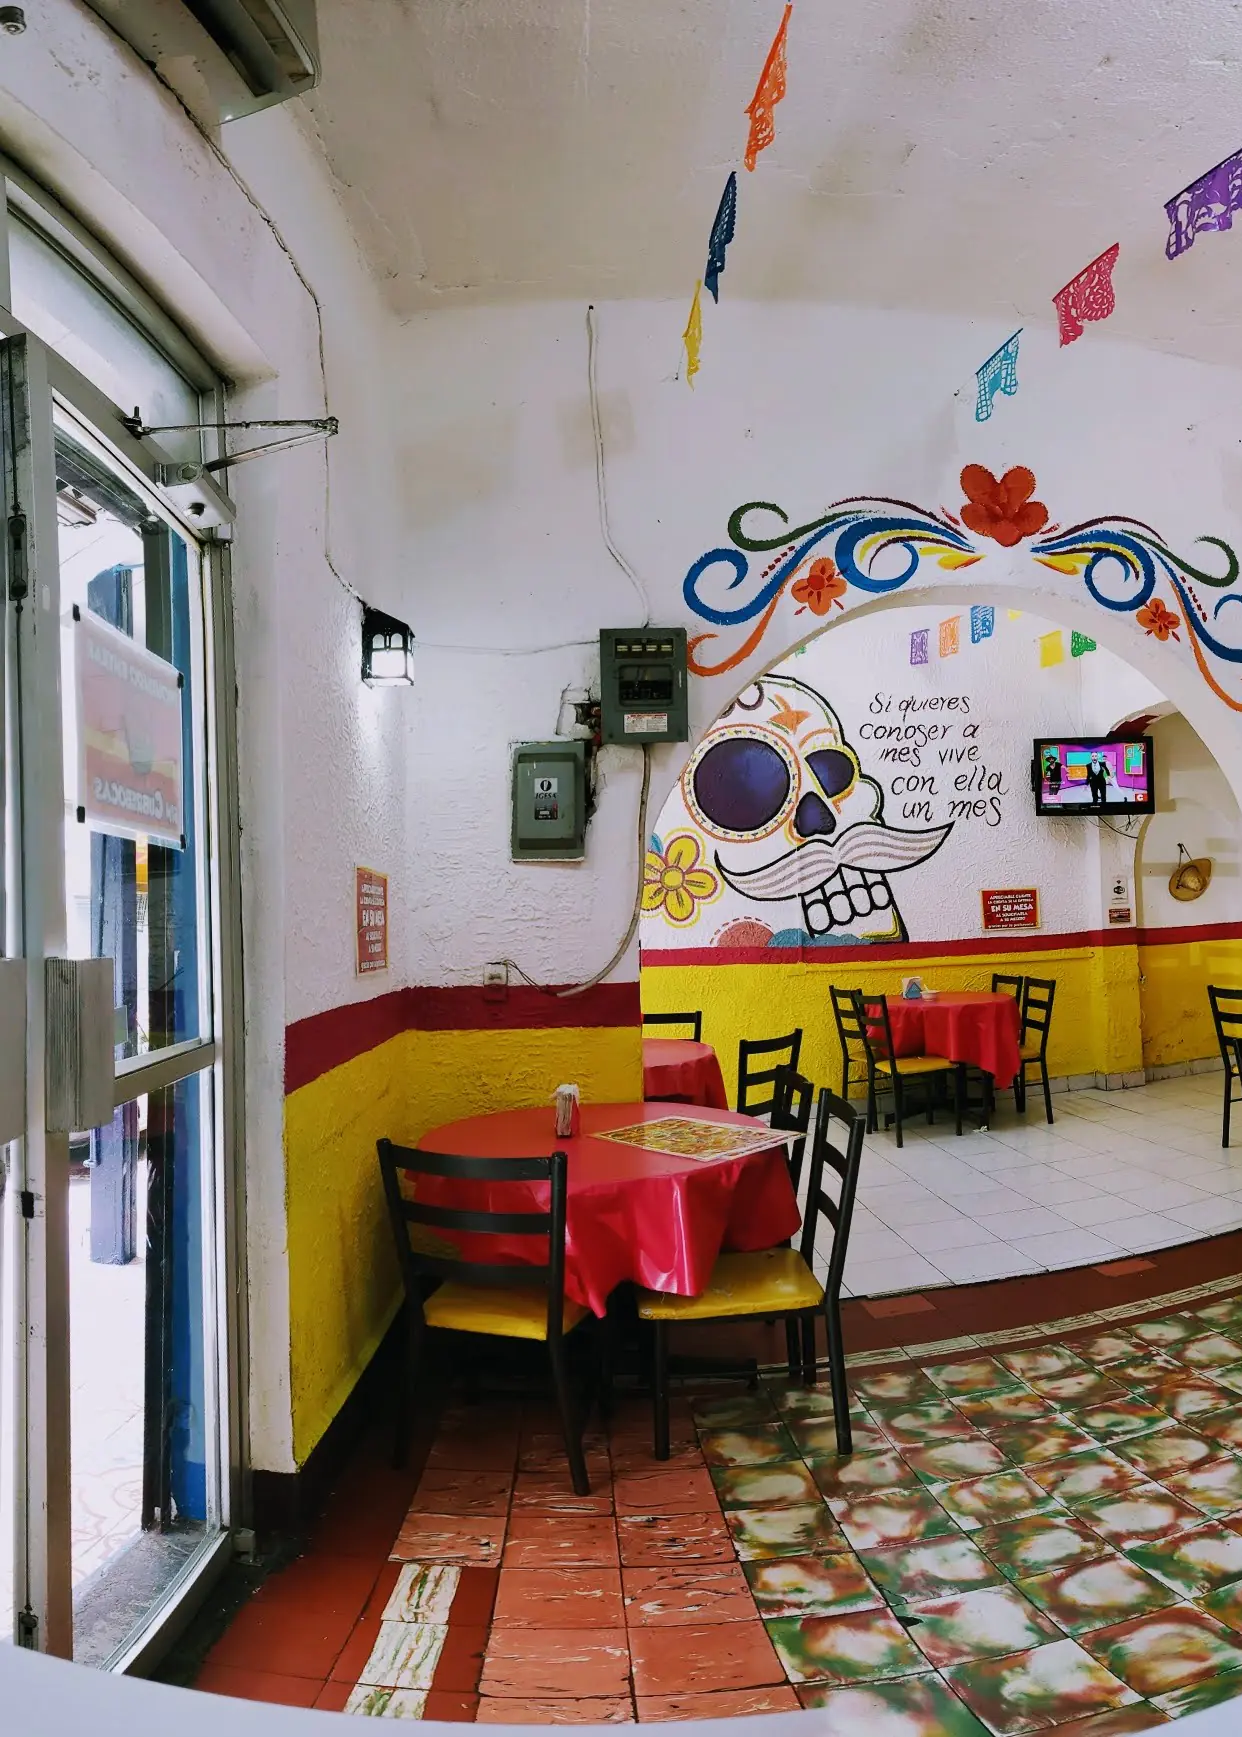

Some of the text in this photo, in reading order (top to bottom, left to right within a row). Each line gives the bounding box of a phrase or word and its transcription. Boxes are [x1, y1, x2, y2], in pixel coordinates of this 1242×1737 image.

[869, 692, 971, 722] Si quieres
[962, 723, 980, 739] a
[938, 745, 982, 765] vive
[891, 764, 1009, 796] con ella
[535, 792, 557, 800] IGESA
[902, 796, 1002, 827] un mes
